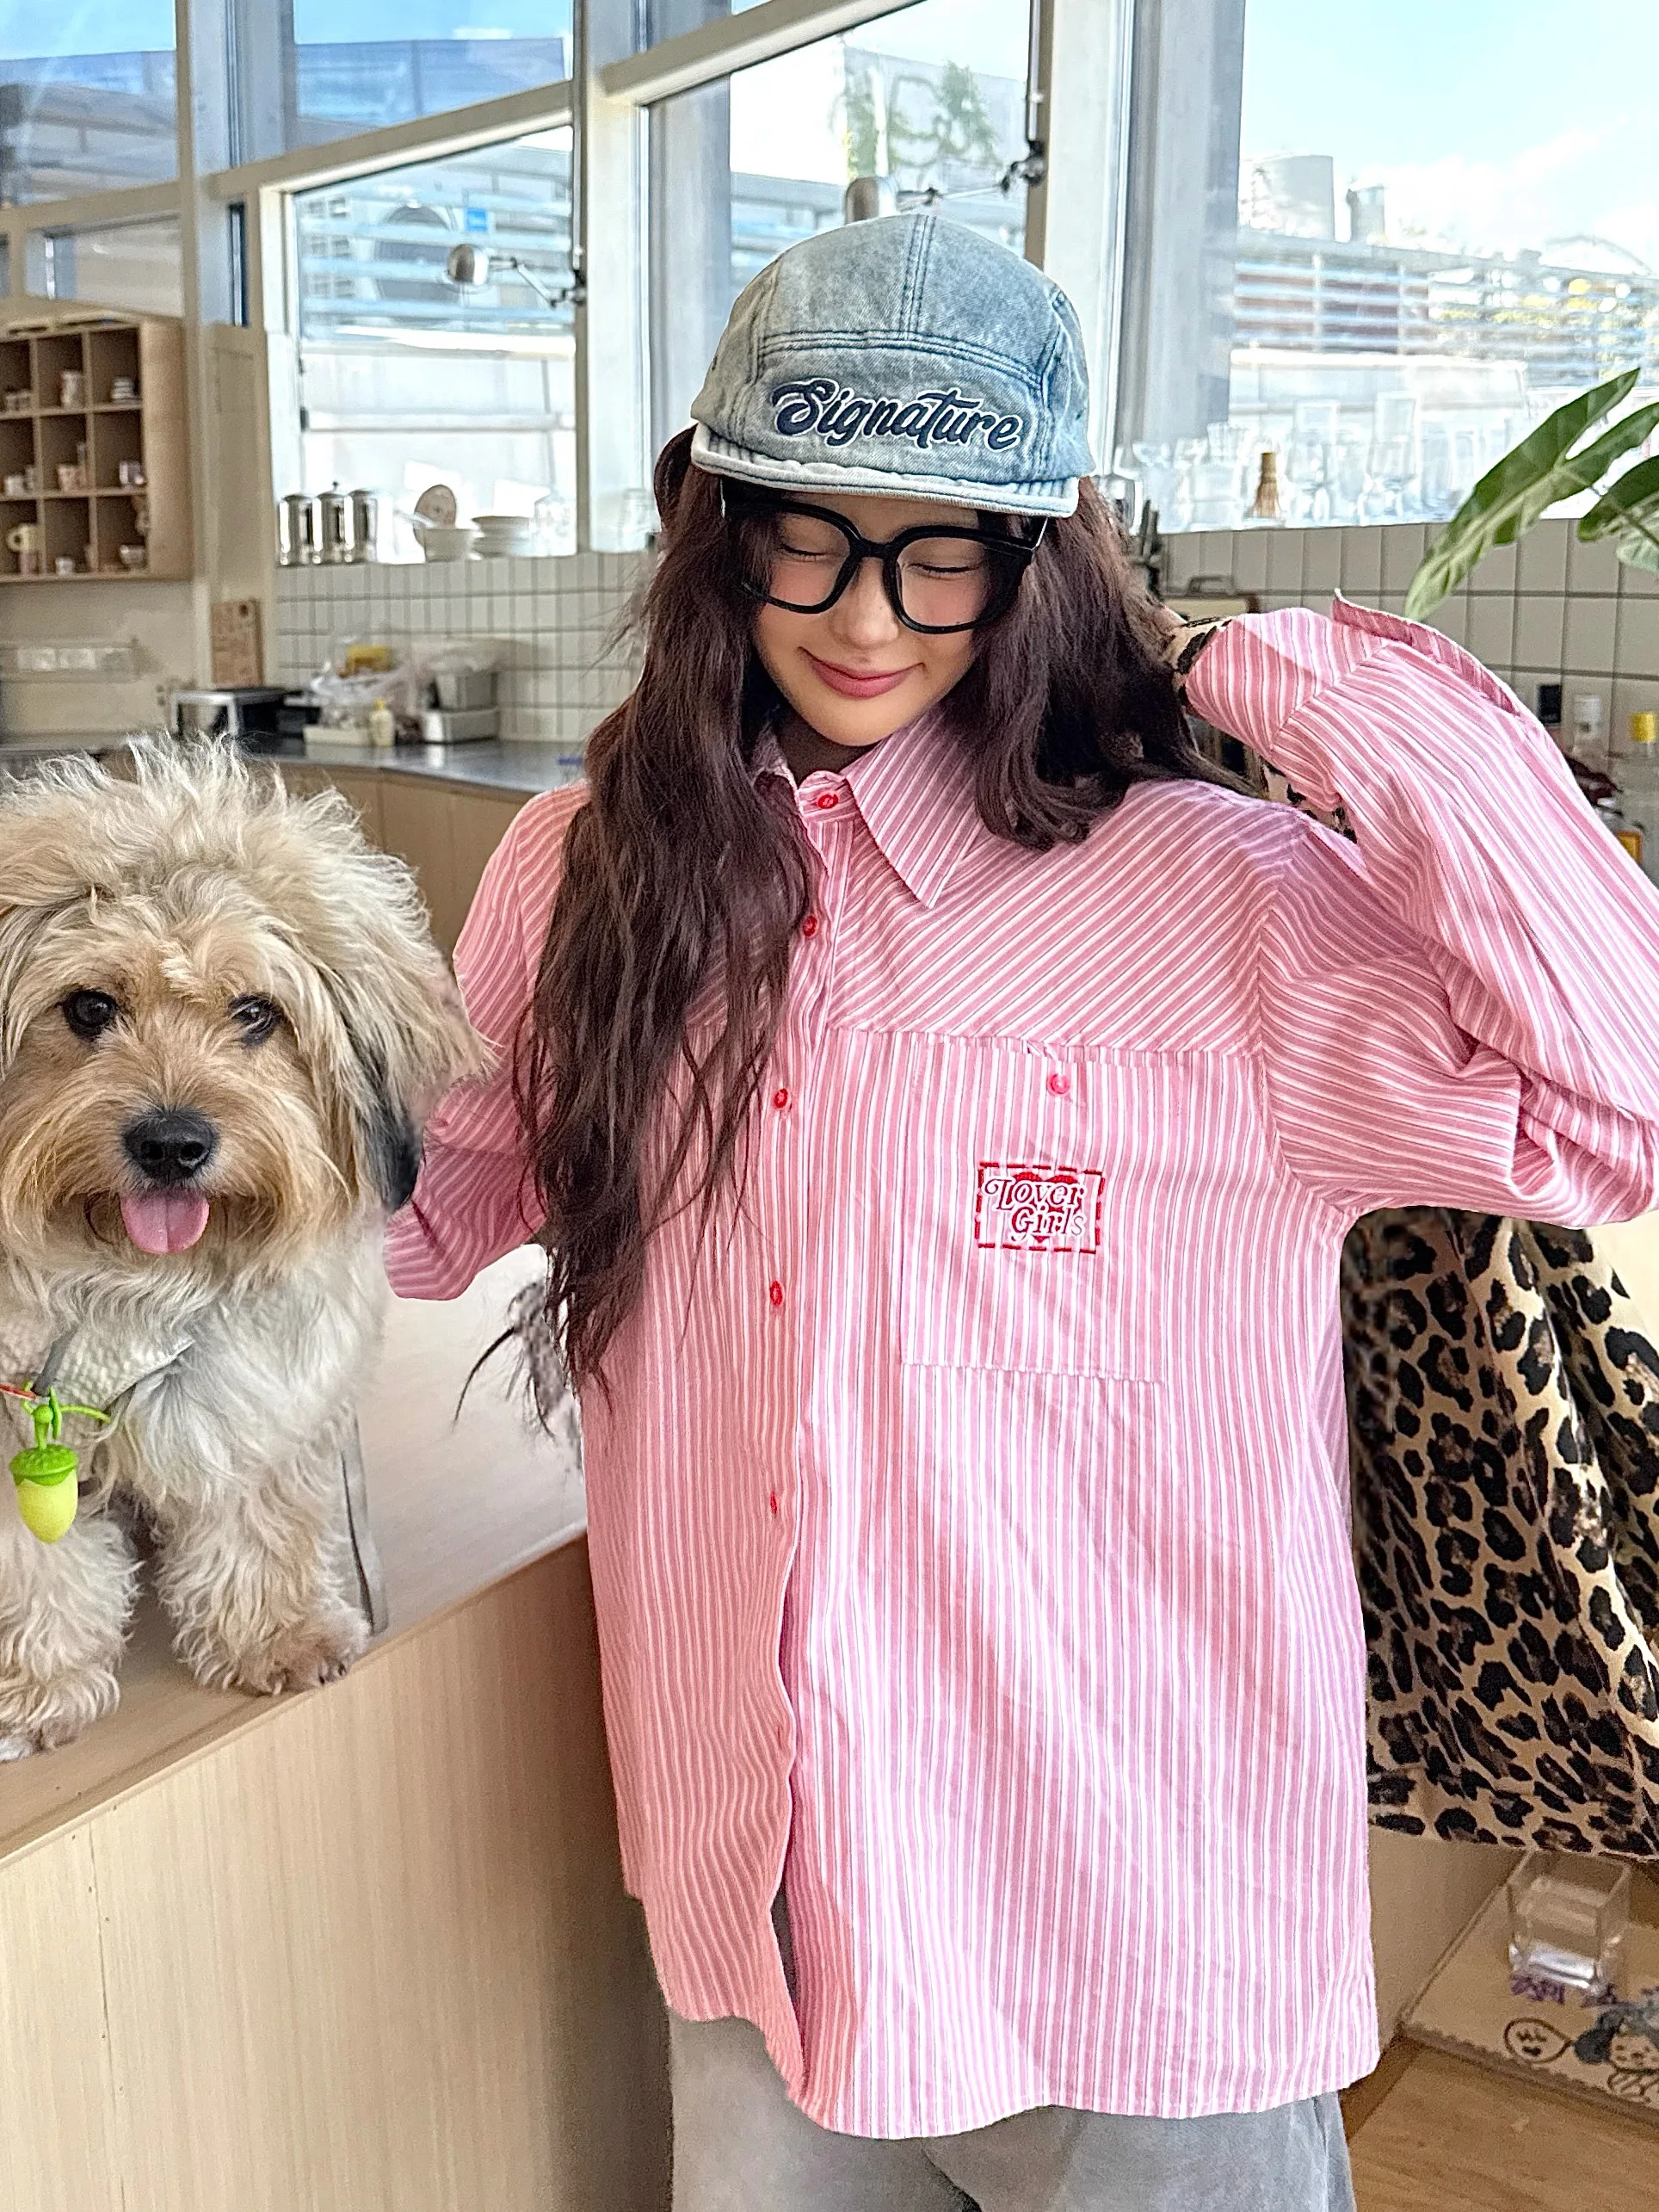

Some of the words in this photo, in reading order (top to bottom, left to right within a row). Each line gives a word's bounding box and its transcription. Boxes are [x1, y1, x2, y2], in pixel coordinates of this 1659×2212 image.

[772, 378, 1023, 452] Signature
[984, 1177, 1086, 1211] Lover
[1010, 1206, 1086, 1242] Girls
